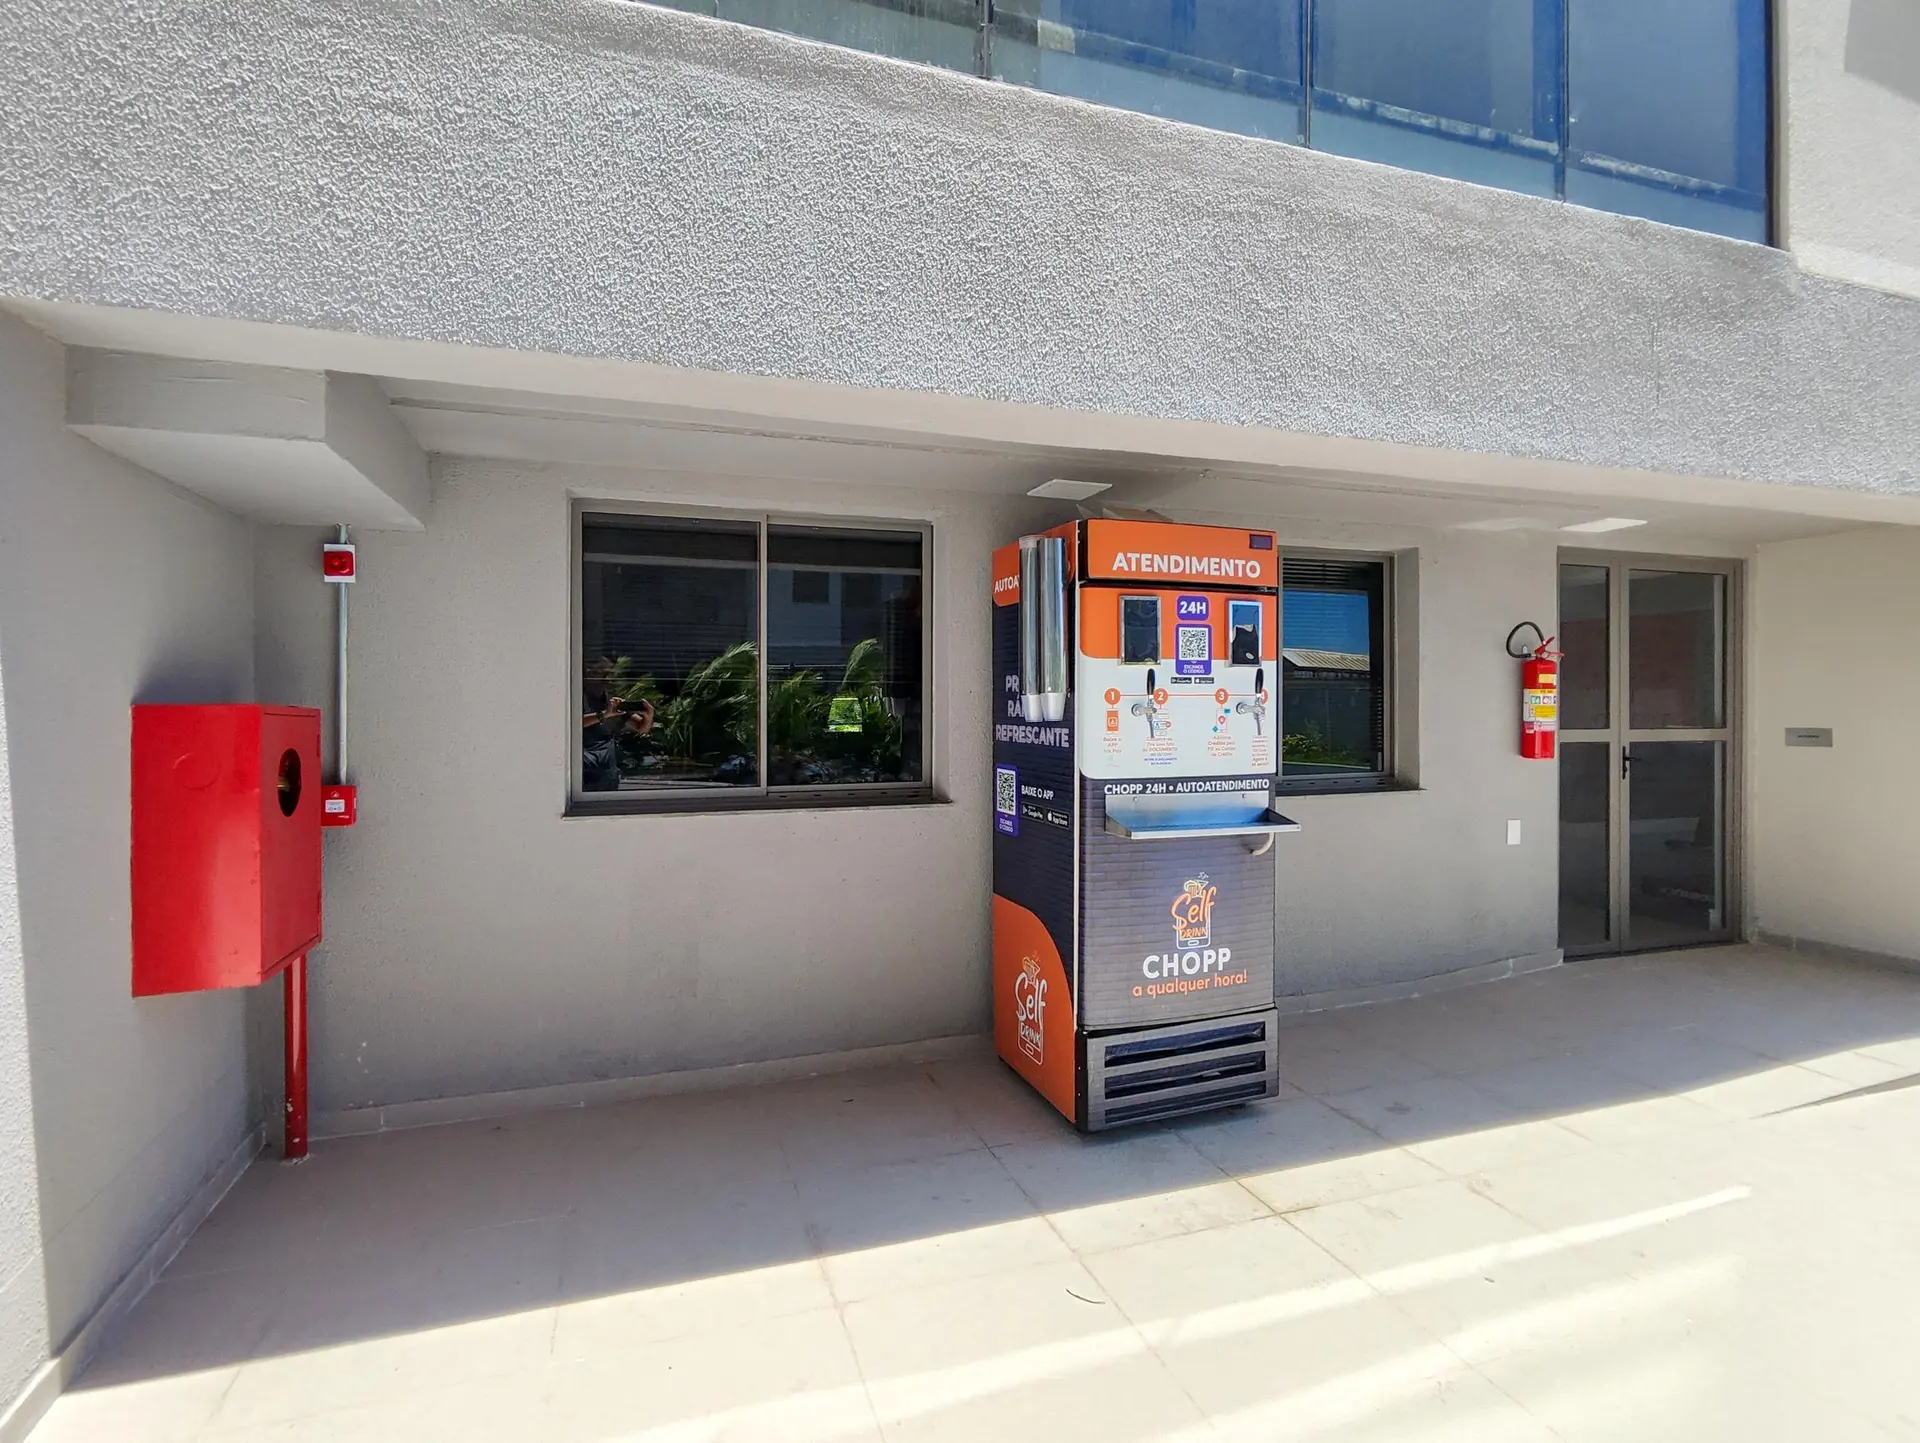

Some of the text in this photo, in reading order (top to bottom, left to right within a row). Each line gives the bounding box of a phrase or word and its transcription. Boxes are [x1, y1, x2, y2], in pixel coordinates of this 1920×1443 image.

[1112, 552, 1261, 579] ATENDIMENTO
[994, 574, 1020, 594] AUTOA
[1179, 601, 1207, 615] 24H
[1110, 691, 1115, 701] 1
[1157, 691, 1164, 701] 2
[1218, 691, 1225, 701] 3
[995, 724, 1070, 748] REFRESCANTE
[1021, 785, 1055, 800] BAIXE O APP
[1104, 778, 1270, 796] CHOPP 24H AUTOATENDIMENTO
[1171, 886, 1217, 931] Self
[1142, 947, 1232, 979] CHOPP
[1132, 969, 1248, 999] a qualquer hora!
[1015, 971, 1048, 1030] Self
[1020, 1021, 1042, 1046] DRINK
